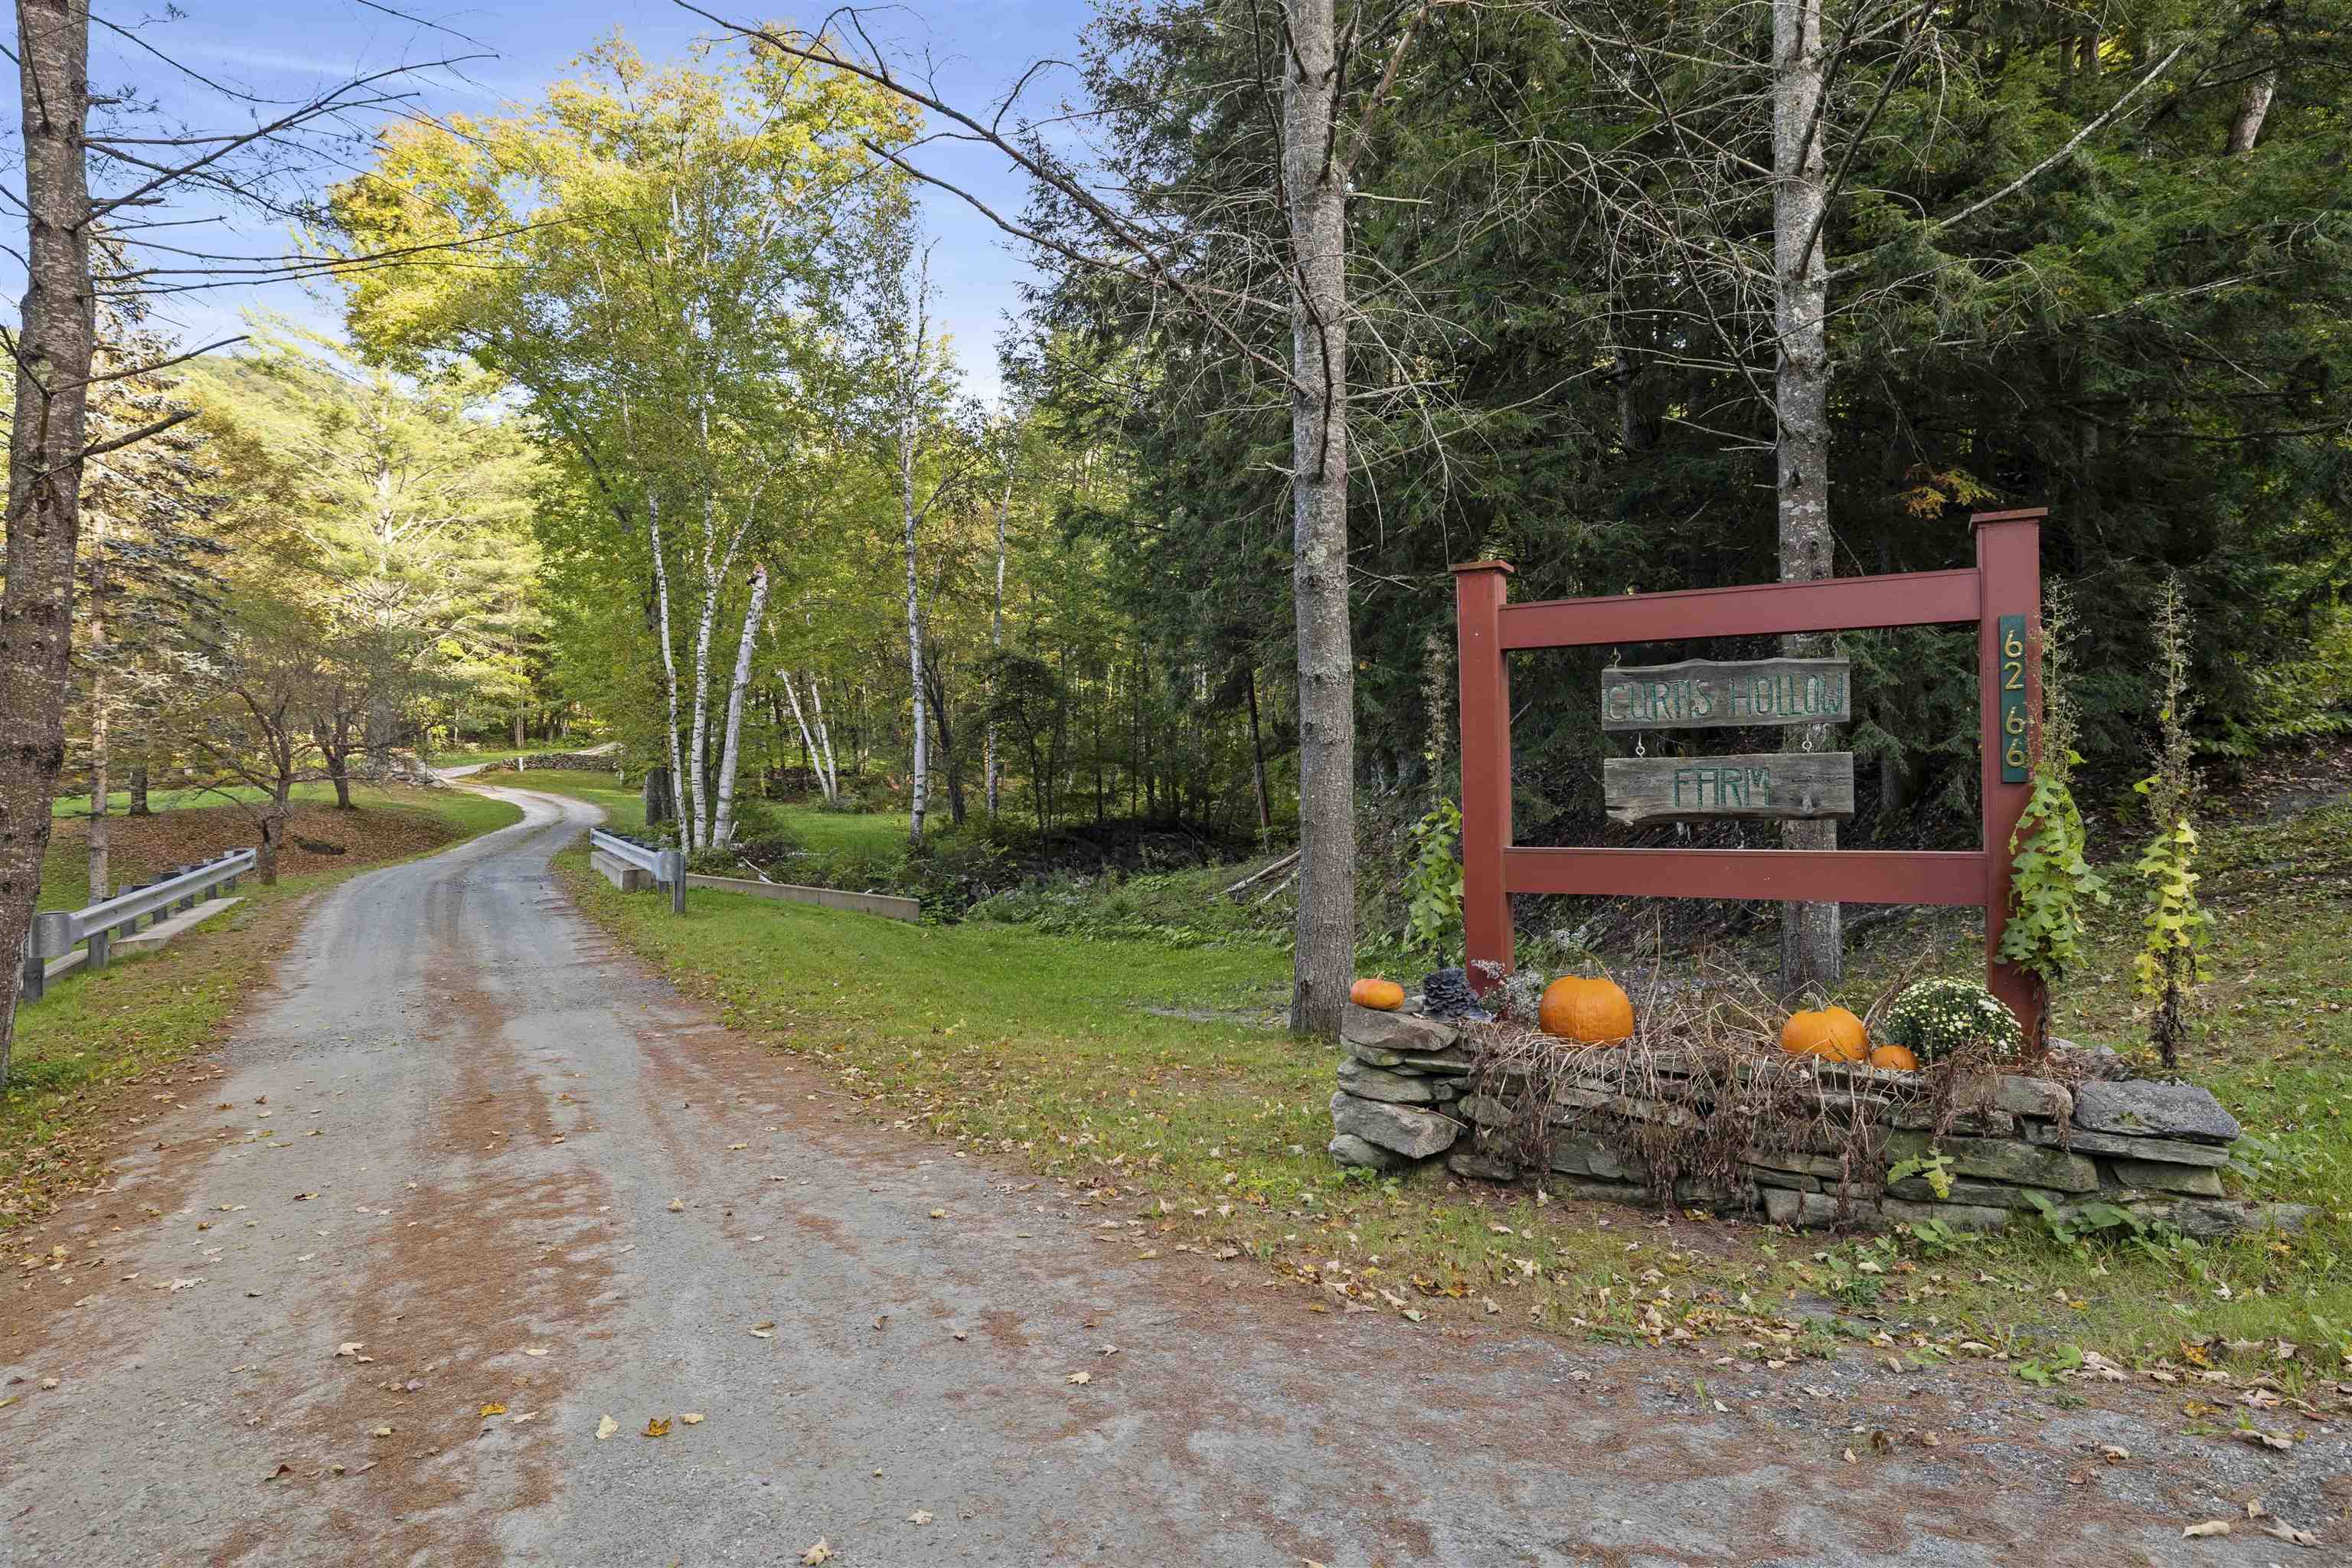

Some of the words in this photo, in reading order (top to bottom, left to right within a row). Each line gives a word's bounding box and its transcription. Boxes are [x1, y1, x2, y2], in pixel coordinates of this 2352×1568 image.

[1606, 679, 1713, 721] CURTIS
[1728, 672, 1844, 717] HOLLOW
[2003, 629, 2024, 768] 6266
[1671, 766, 1771, 808] FARM
